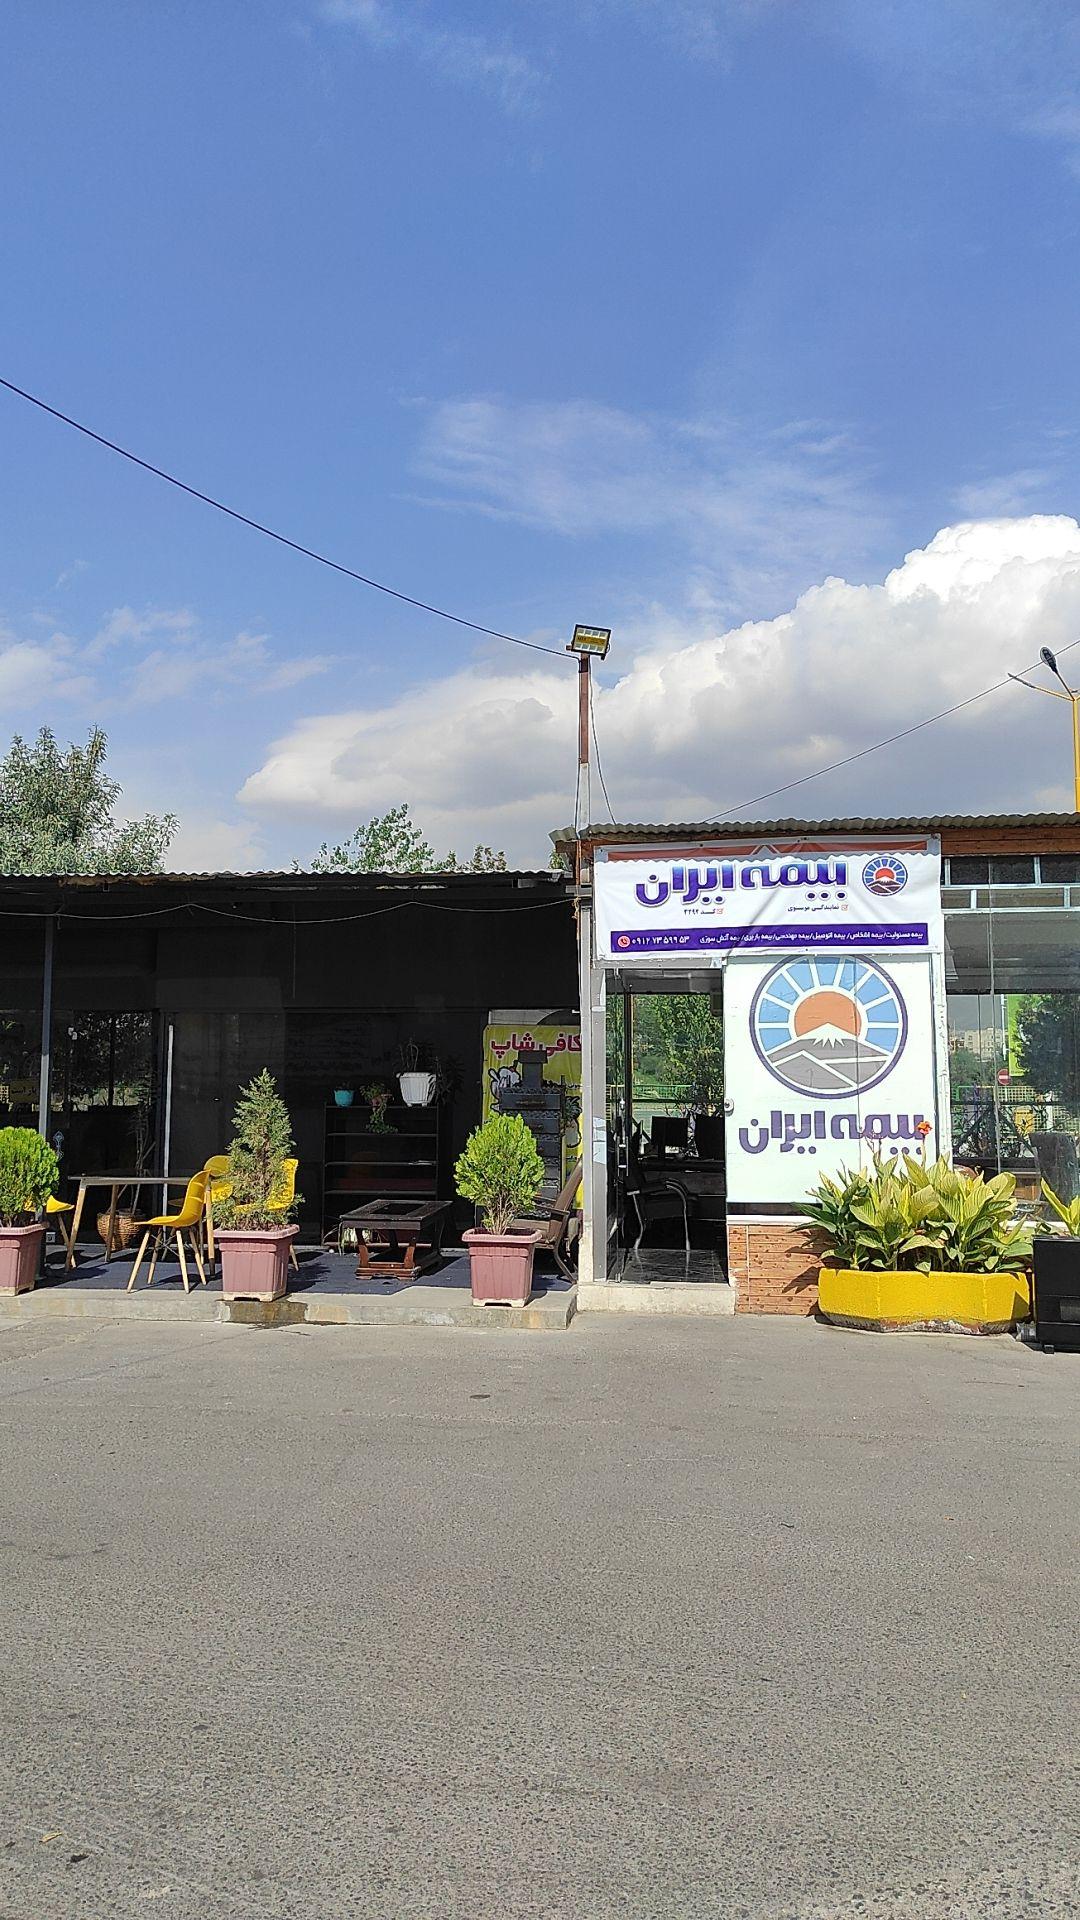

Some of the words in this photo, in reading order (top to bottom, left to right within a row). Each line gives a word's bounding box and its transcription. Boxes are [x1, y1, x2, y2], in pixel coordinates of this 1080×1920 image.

[635, 864, 735, 906] ایران
[740, 862, 848, 900] بیمه
[811, 904, 840, 912] نمایندگی
[491, 1032, 536, 1059] شاپ
[538, 1033, 582, 1057] کافی
[738, 1110, 826, 1154] ایران
[830, 1114, 925, 1155] بیمه
